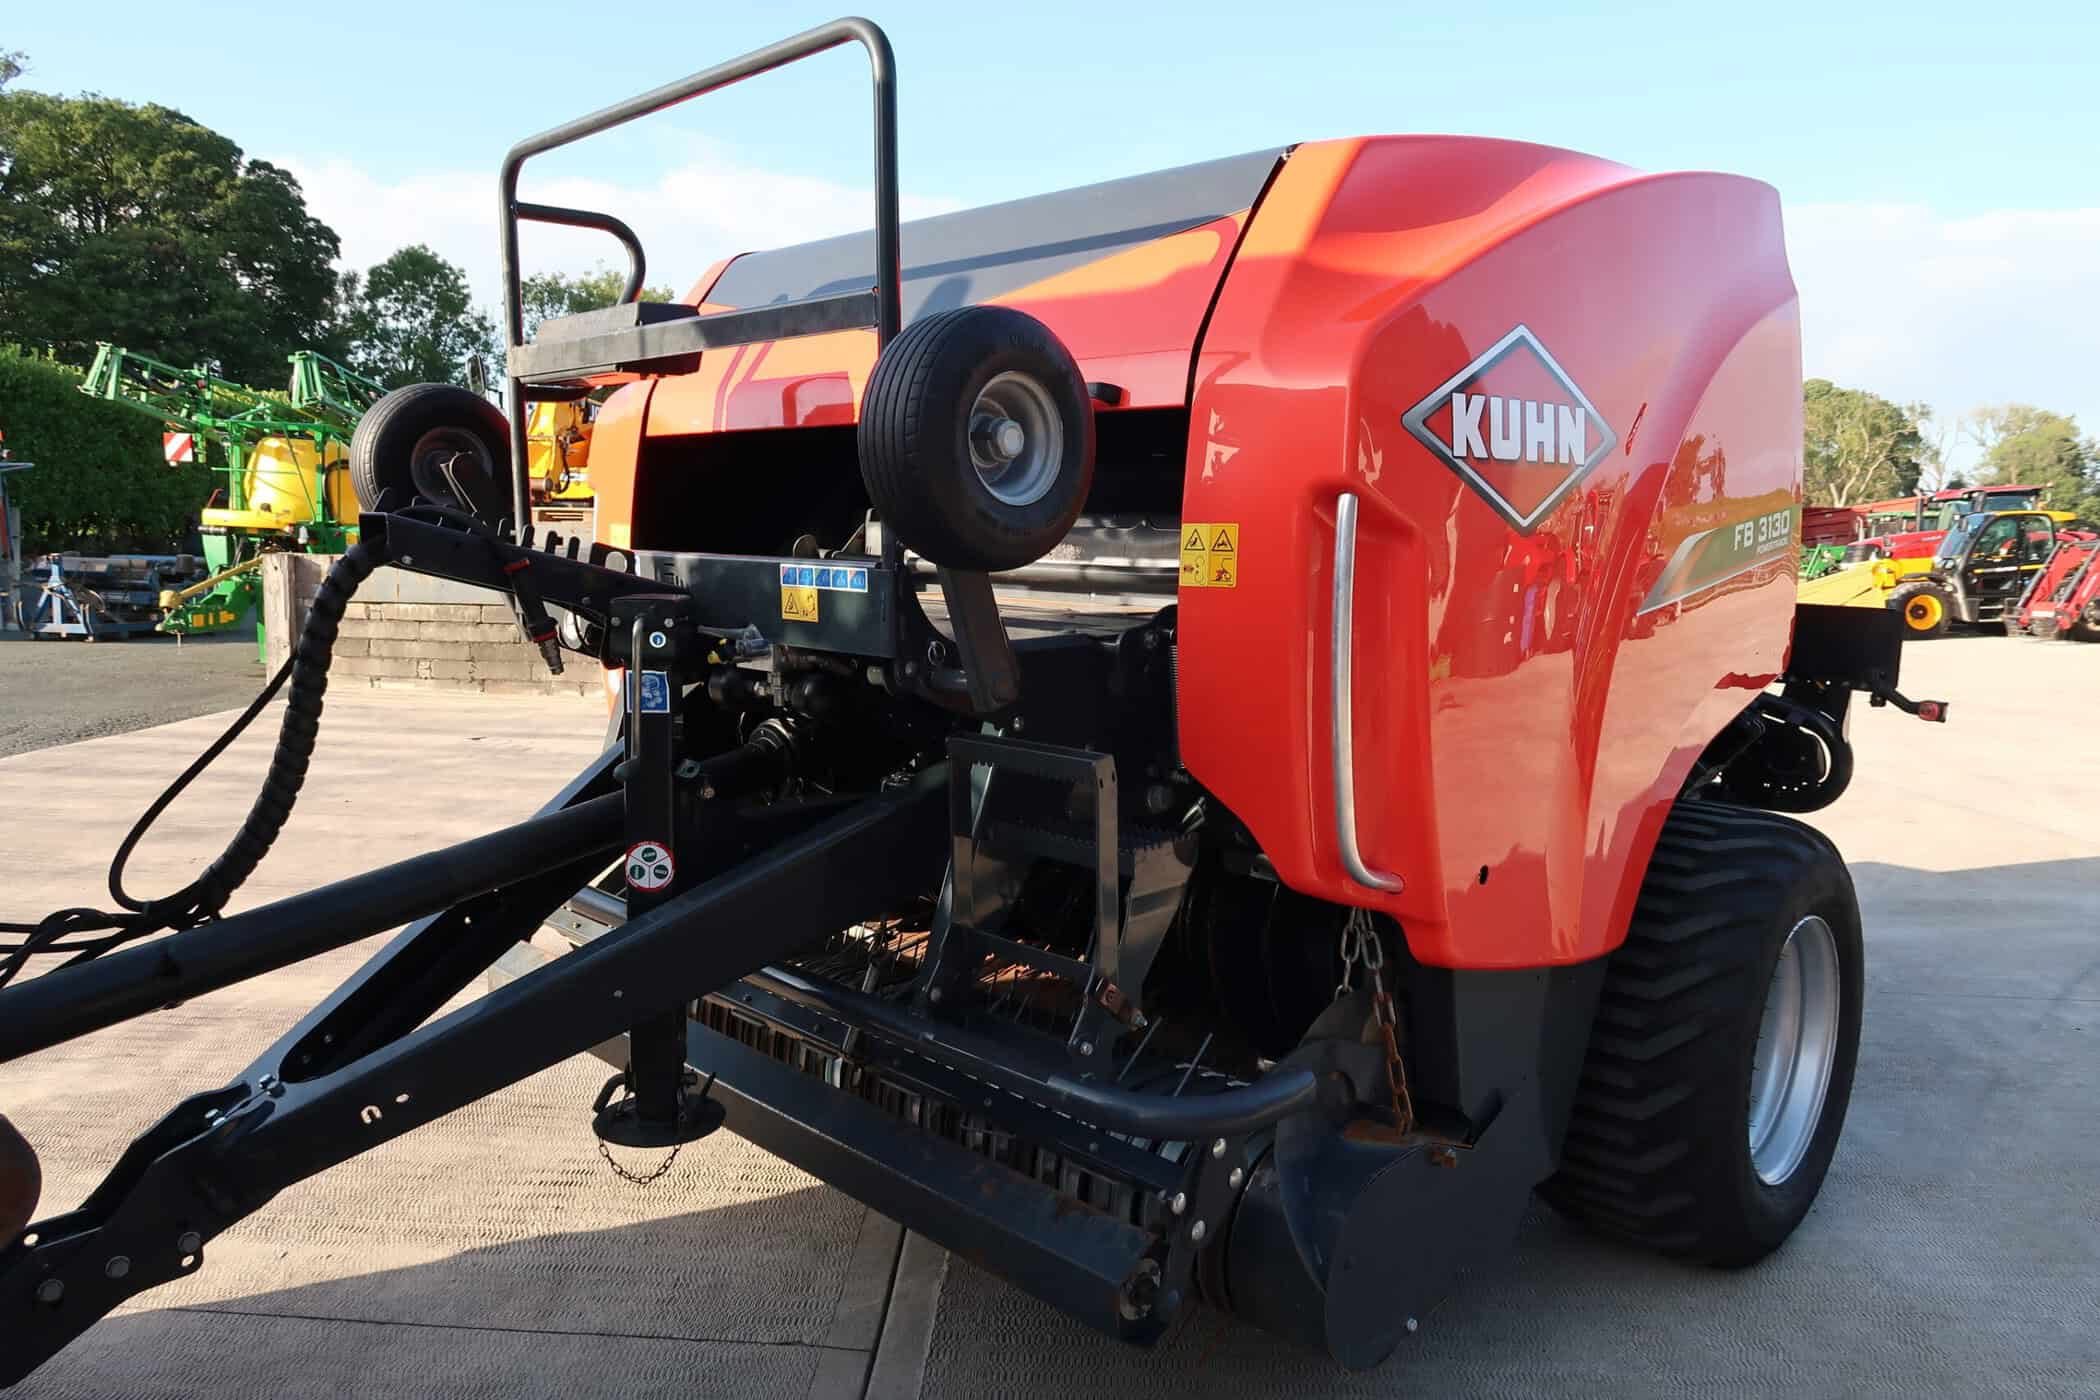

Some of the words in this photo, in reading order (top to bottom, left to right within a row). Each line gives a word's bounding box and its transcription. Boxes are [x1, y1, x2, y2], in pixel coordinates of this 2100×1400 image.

[1451, 392, 1585, 466] KUHN
[1734, 521, 1754, 551] FB
[1758, 509, 1791, 542] 3130
